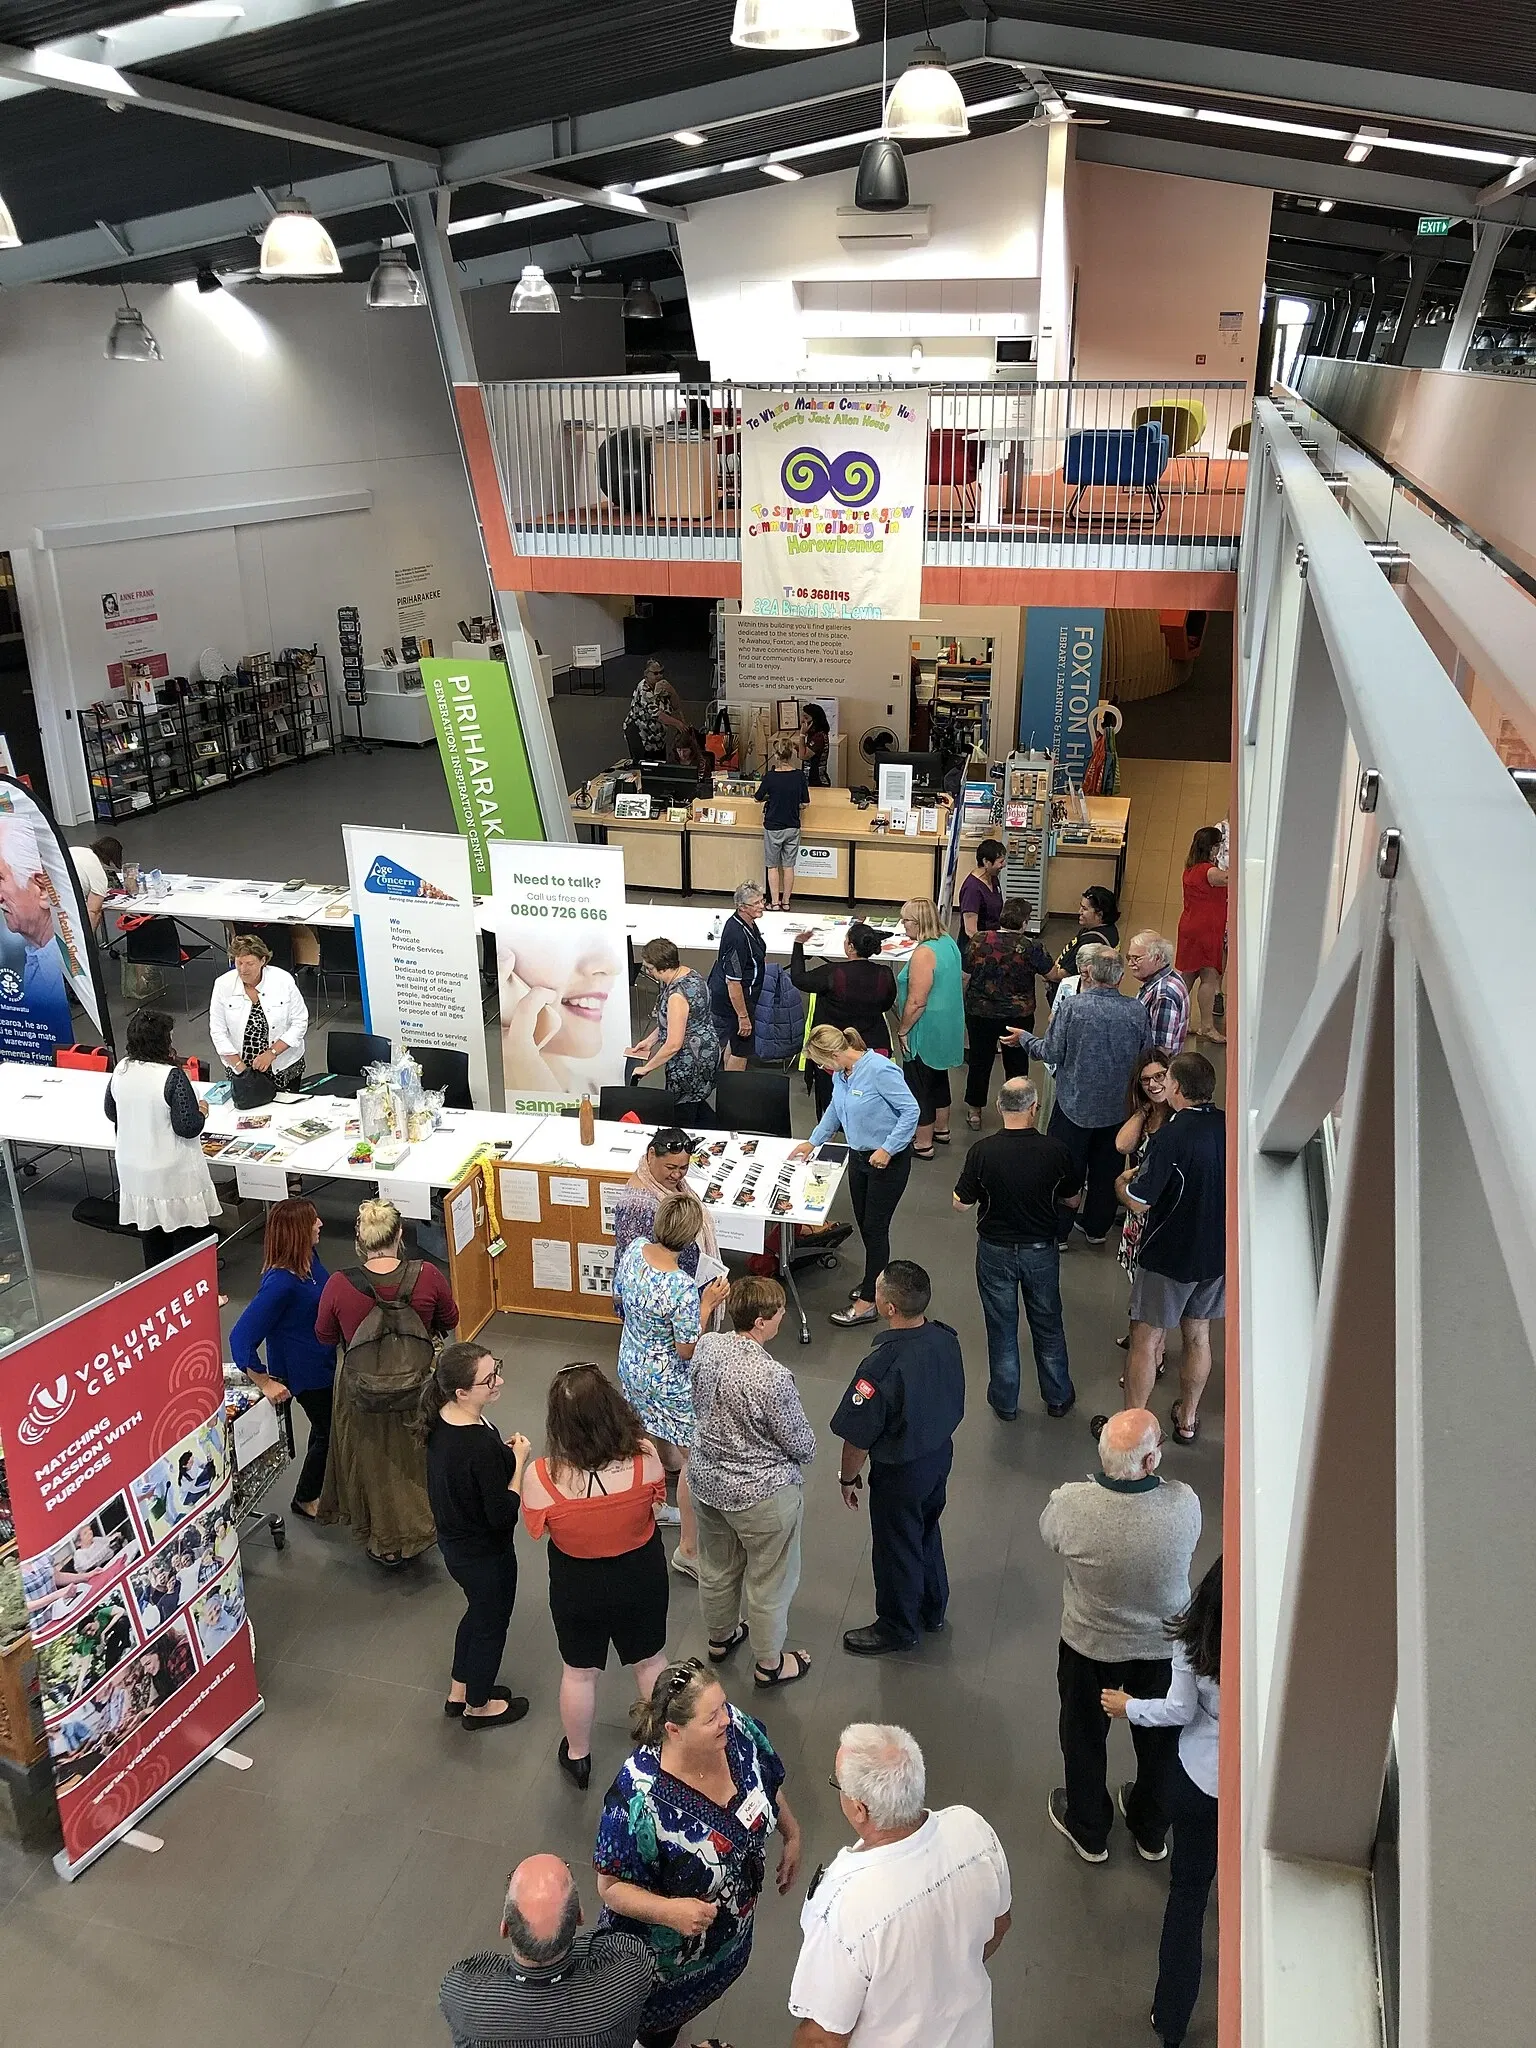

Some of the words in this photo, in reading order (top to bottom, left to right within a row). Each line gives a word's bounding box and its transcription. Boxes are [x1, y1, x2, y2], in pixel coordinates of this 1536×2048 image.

[1420, 222, 1442, 233] EXIT
[746, 418, 759, 431] Te
[759, 401, 790, 424] Whare
[795, 397, 835, 410] Mahana
[839, 398, 893, 419] Community
[897, 404, 917, 423] Hub
[808, 412, 830, 424] Jack
[833, 414, 859, 425] Allen
[862, 415, 890, 432] House
[751, 504, 768, 519] To
[772, 505, 823, 521] support,
[824, 507, 870, 520] nurture
[879, 505, 914, 523] grow
[749, 519, 811, 538] community
[816, 520, 874, 539] wellbeing
[885, 520, 900, 534] in
[787, 535, 884, 555] Horowhenua
[120, 592, 134, 601] ANNE
[136, 589, 154, 599] FRANK
[397, 590, 440, 606] PIRIHARAKEKE
[783, 587, 795, 598] T:
[797, 588, 808, 599] 06
[810, 589, 850, 601] 3681195
[752, 598, 779, 616] 32A
[782, 600, 818, 618] Bristol
[770, 622, 794, 630] building
[1057, 626, 1068, 670] LIBRARY,
[763, 655, 796, 663] community
[1067, 626, 1094, 734] FOXTON
[1053, 671, 1066, 722] LEARNING
[448, 675, 505, 838] PIRIHARAK
[433, 679, 458, 756] GENERATION
[450, 754, 476, 831] INSPIRATION
[468, 829, 486, 873] CENTRE
[370, 862, 392, 878] Age
[377, 875, 415, 886] Concern
[514, 873, 548, 885] Need
[551, 876, 565, 886] to
[568, 877, 601, 888] talk?
[558, 894, 576, 902] free
[511, 904, 548, 917] 0800
[552, 906, 576, 919] 726
[581, 908, 607, 920] 666
[57, 911, 74, 945] Health
[392, 935, 420, 944] Advocate
[393, 944, 415, 952] Provide
[417, 946, 444, 954] Services
[395, 966, 426, 974] Dedicated
[436, 970, 468, 980] promoting
[407, 975, 428, 984] quality
[410, 984, 428, 992] being
[397, 991, 420, 999] people,
[421, 994, 456, 1003] advocating
[409, 1008, 430, 1016] people
[423, 1001, 446, 1010] healthy
[448, 1004, 465, 1012] aging
[25, 1020, 34, 1029] he
[36, 1023, 48, 1031] aro
[5, 1028, 13, 1036] te
[14, 1028, 36, 1039] hunga
[38, 1032, 56, 1042] mate
[401, 1028, 435, 1037] Committed
[445, 1033, 467, 1042] serving
[4, 1038, 40, 1048] wareware
[0, 1049, 30, 1058] ementia
[74, 1279, 210, 1382] VOLUNTEER
[86, 1314, 192, 1396] CENTRAL
[34, 1416, 112, 1482] MATCHING
[39, 1442, 104, 1497] PASSION
[104, 1410, 143, 1444] WITH
[44, 1452, 112, 1512] PURPOSE
[92, 1662, 236, 1805] www.volunteercentral.nz
